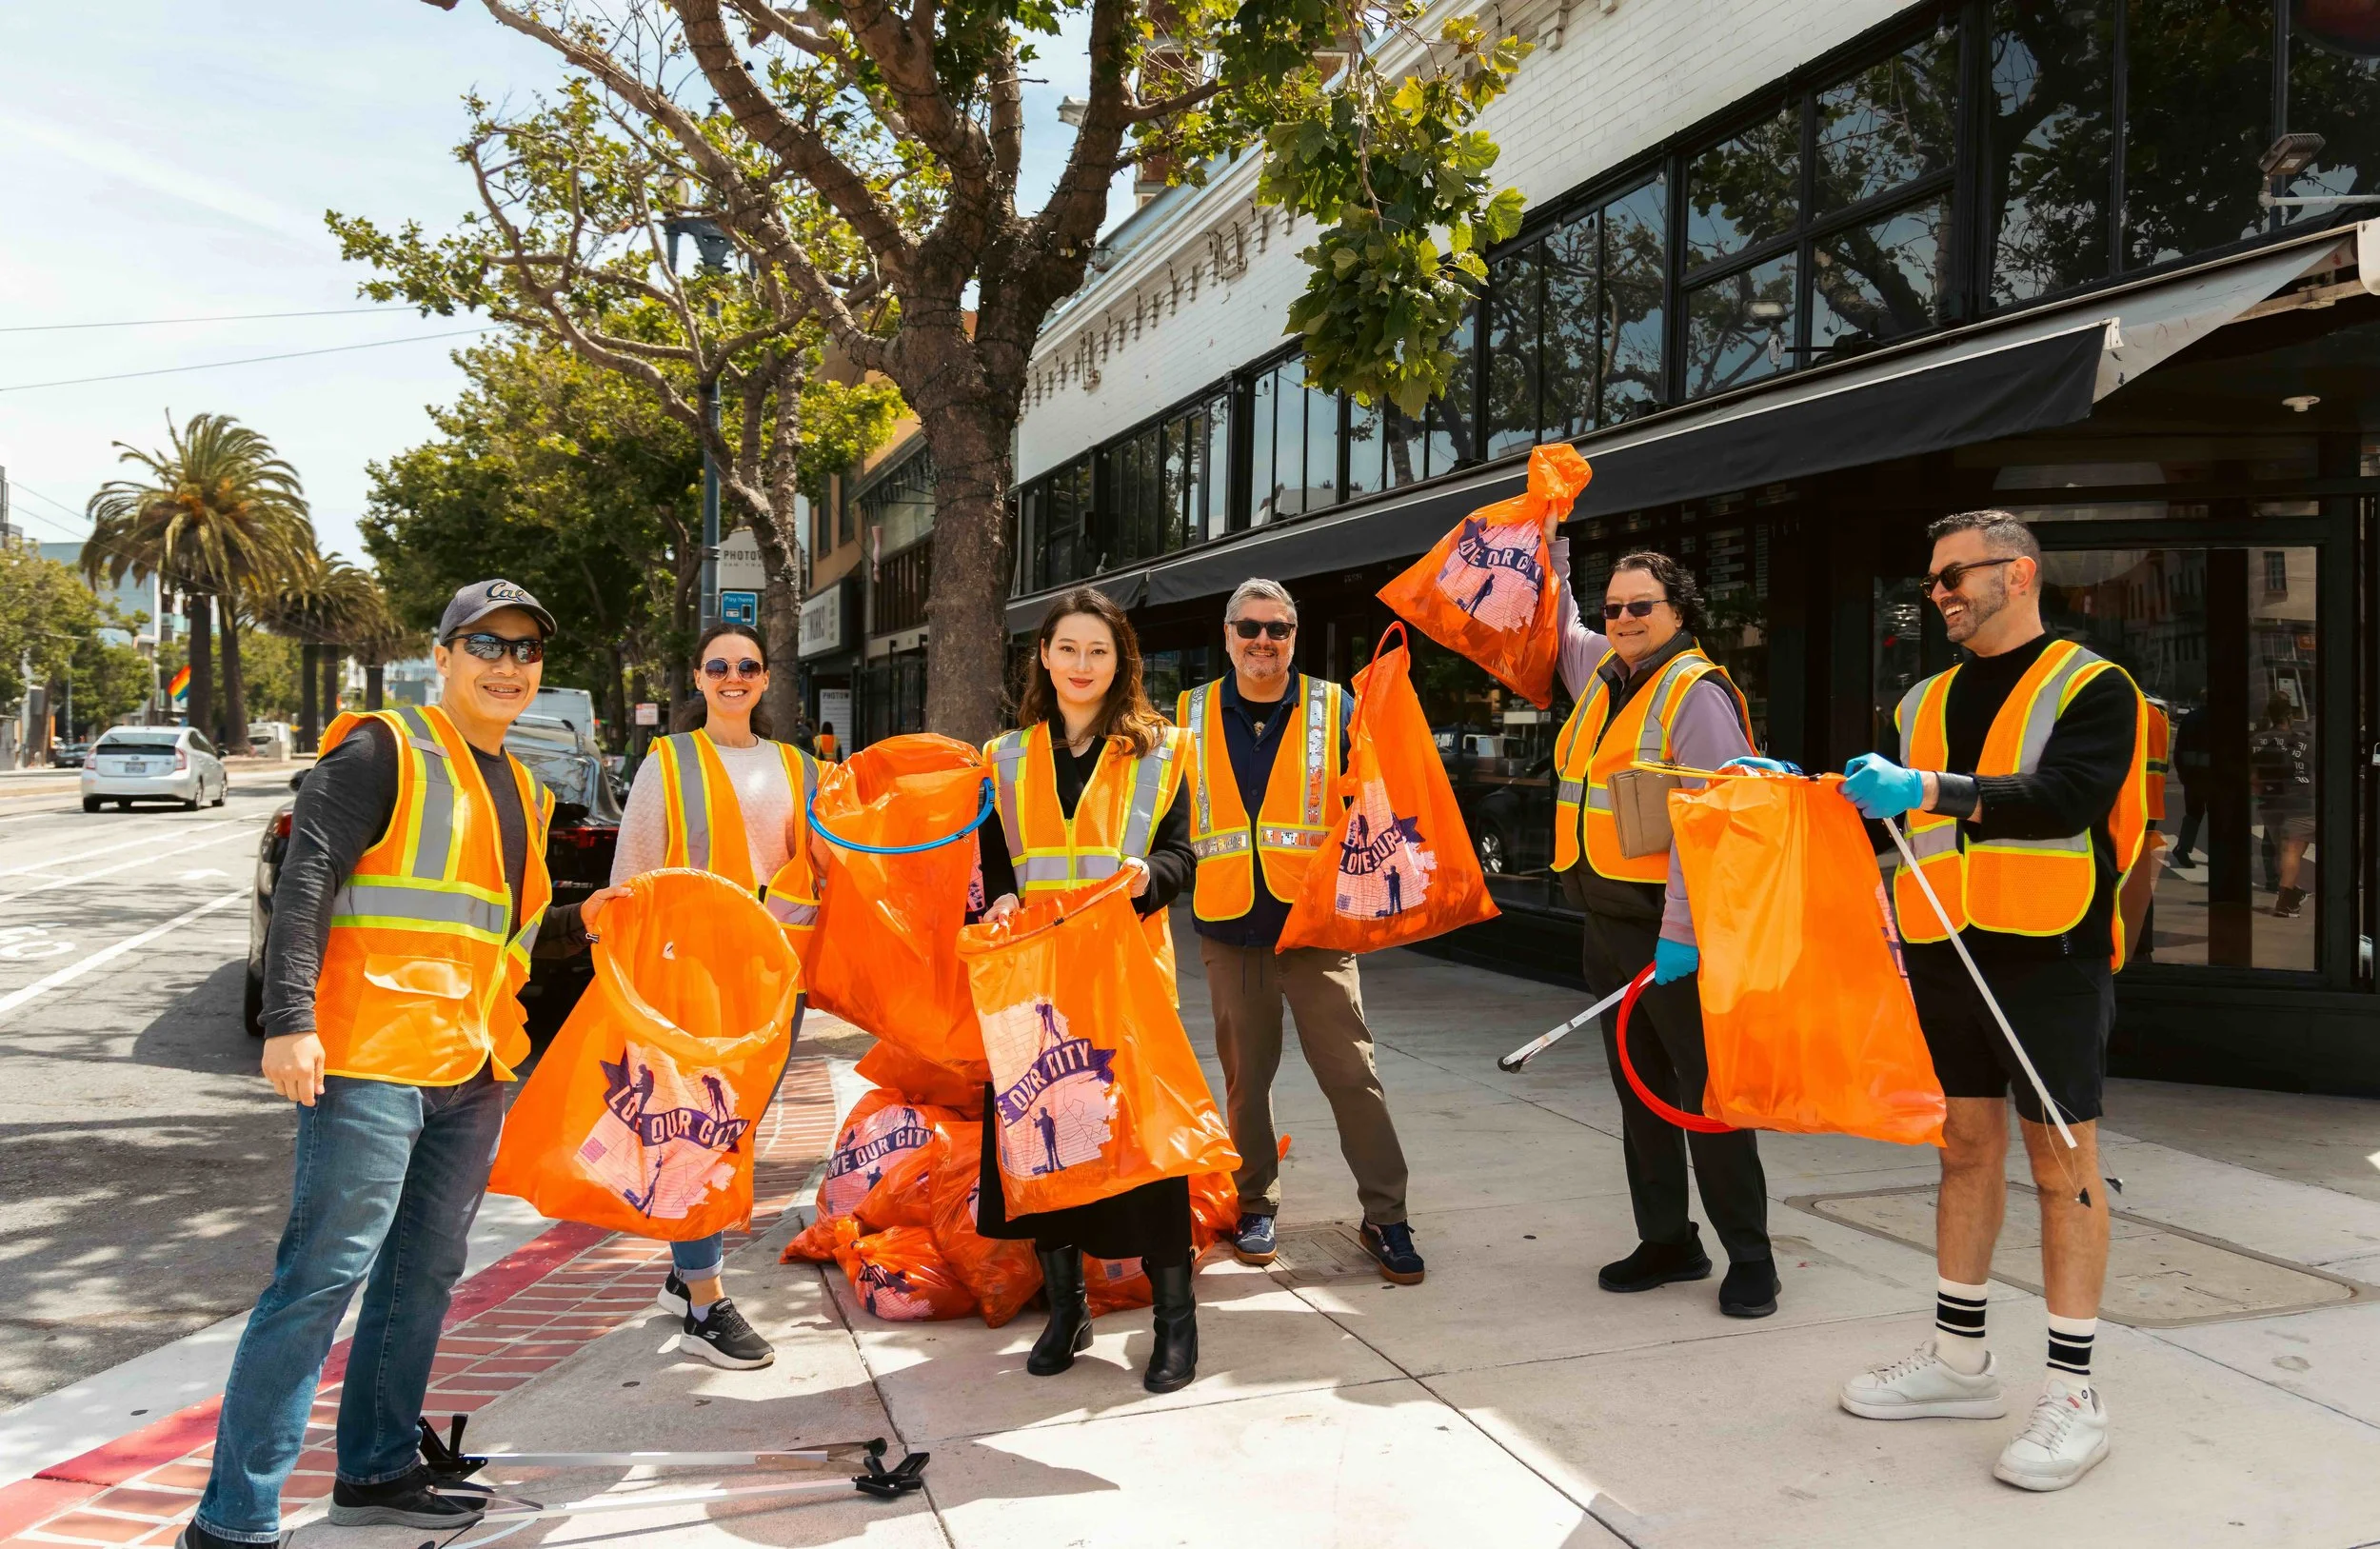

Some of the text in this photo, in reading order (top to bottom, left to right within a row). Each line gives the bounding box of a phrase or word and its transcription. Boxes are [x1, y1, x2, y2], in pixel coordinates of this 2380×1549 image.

[486, 582, 524, 603] Cal
[1009, 1042, 1090, 1112] OUR CITY
[651, 1109, 693, 1143] OUR
[855, 1137, 891, 1167] OUR
[896, 1128, 934, 1147] CITY
